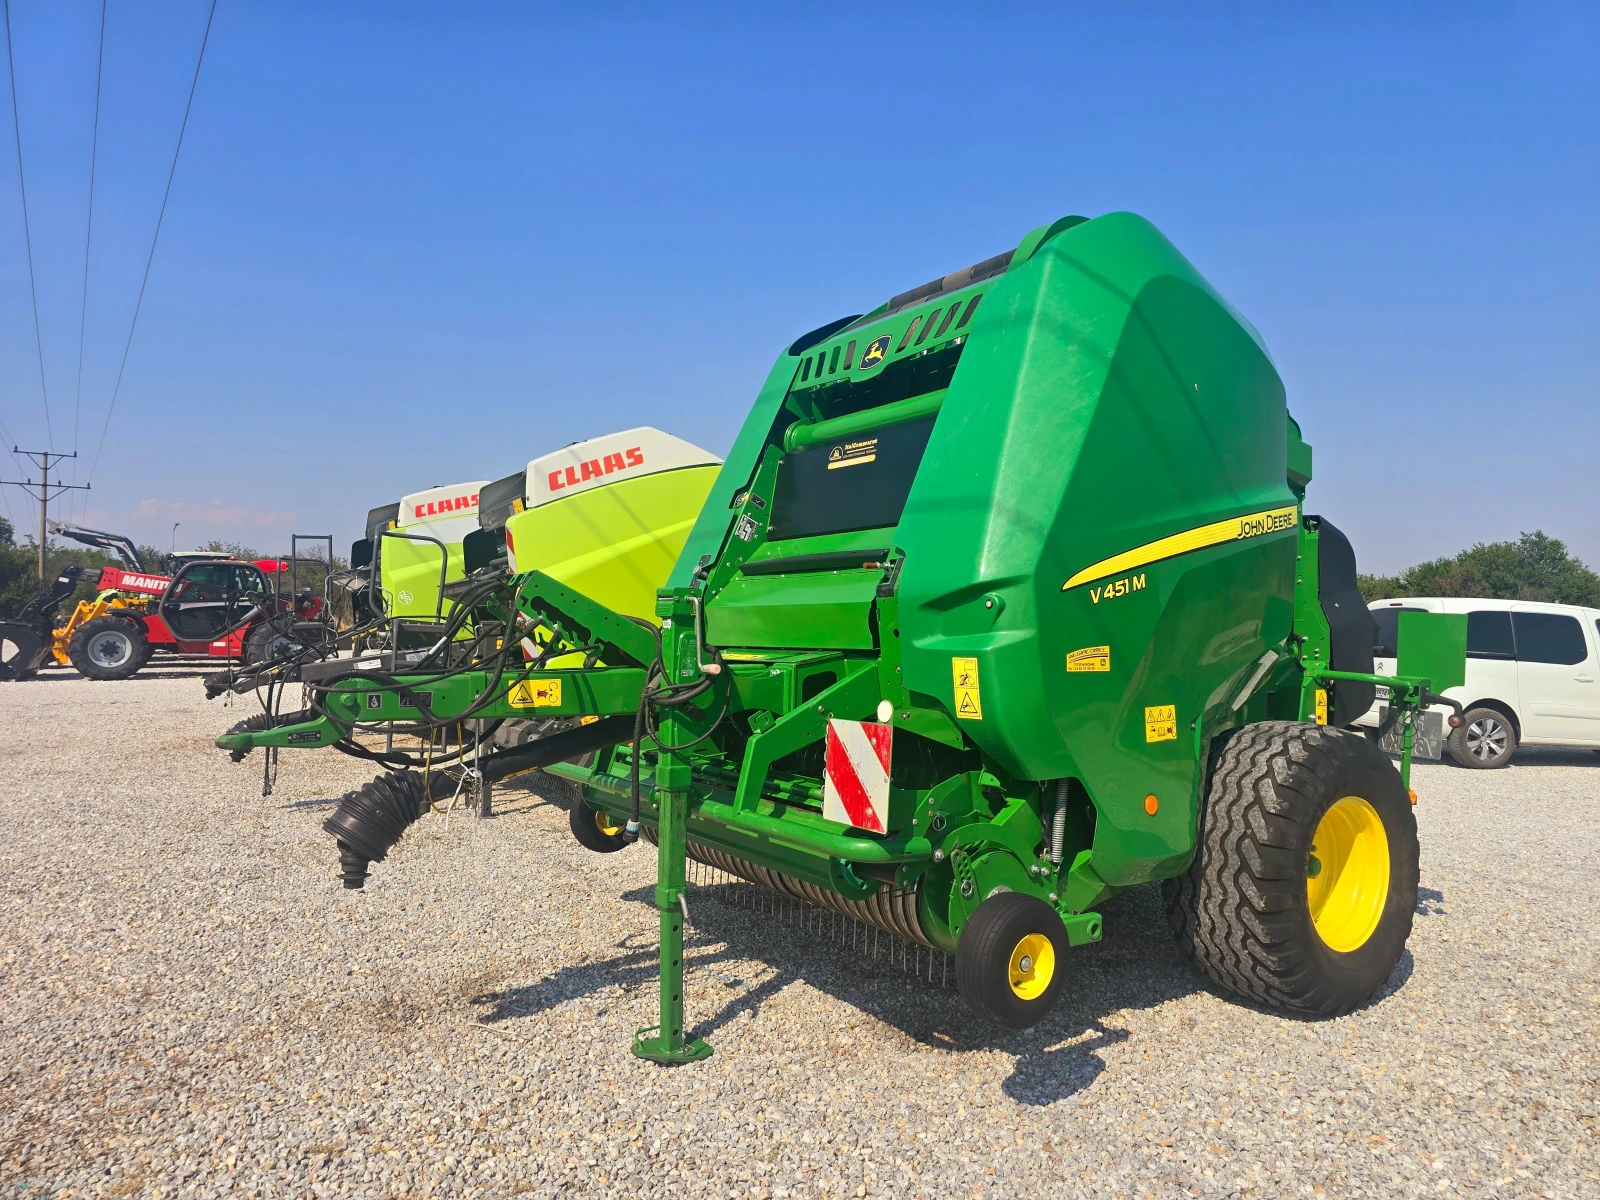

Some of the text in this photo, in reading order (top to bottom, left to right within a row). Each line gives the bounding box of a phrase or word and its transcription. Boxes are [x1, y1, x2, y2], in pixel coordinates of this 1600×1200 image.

[548, 446, 644, 491] CLAAS
[414, 493, 479, 518] CLAAS
[1237, 513, 1292, 540] JOHN DEERE
[1089, 573, 1146, 605] V 451 M
